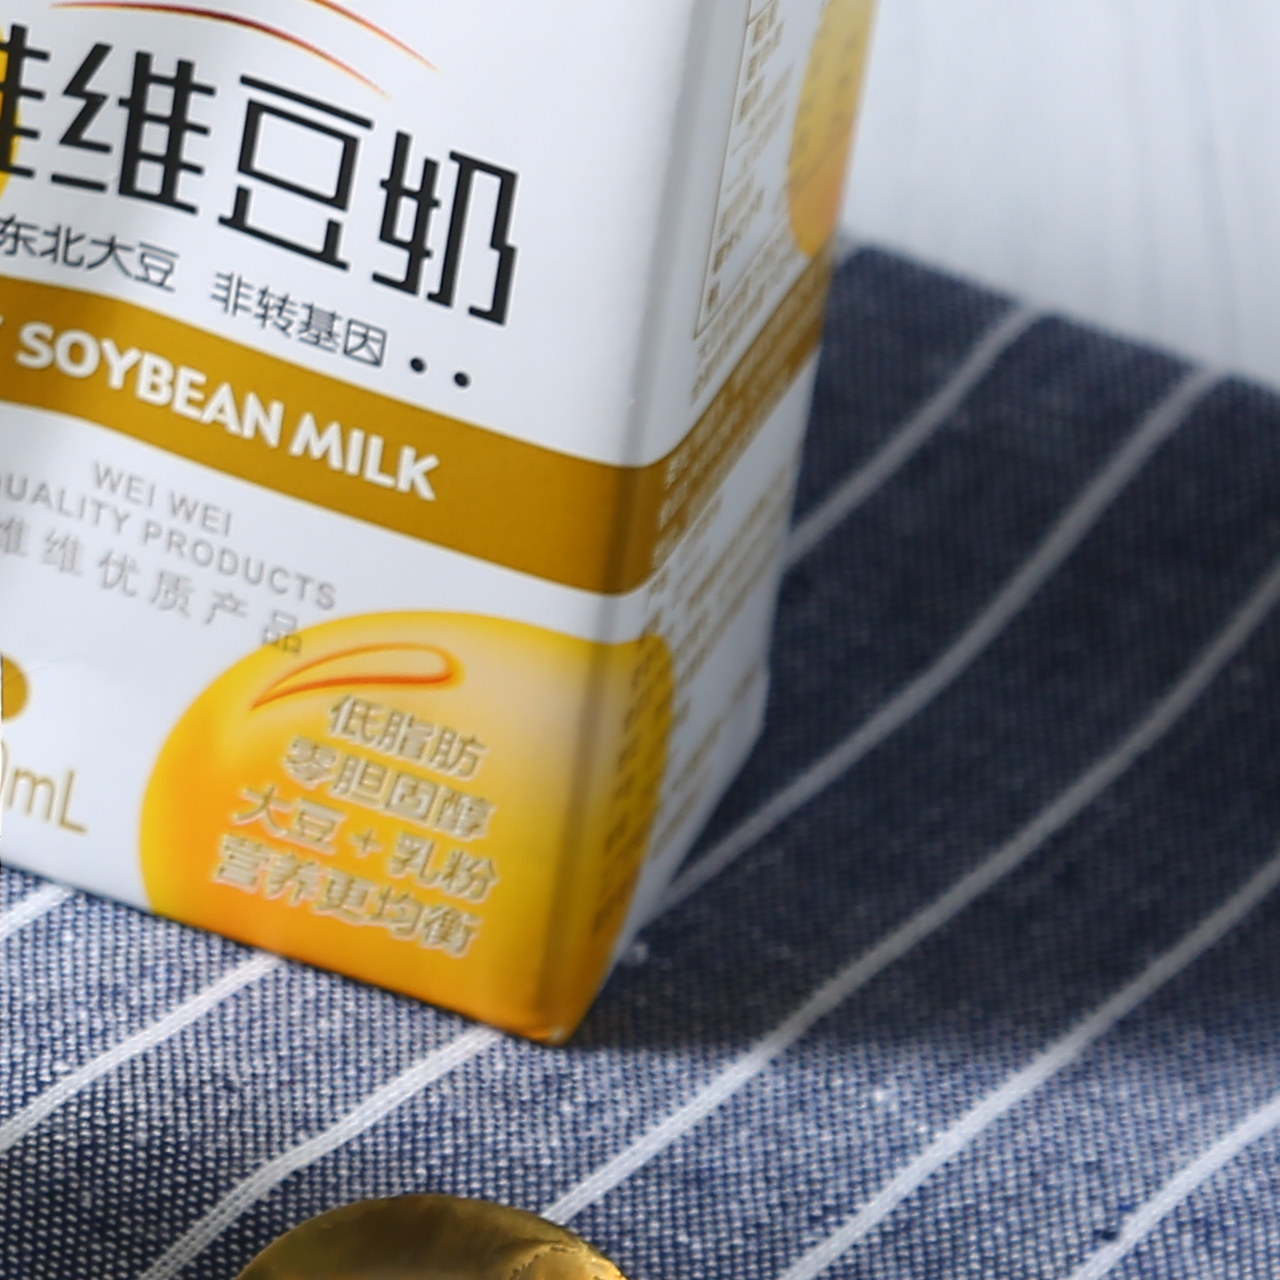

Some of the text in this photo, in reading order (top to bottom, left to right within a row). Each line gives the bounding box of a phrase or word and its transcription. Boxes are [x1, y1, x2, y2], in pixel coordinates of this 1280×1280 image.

[210, 271, 388, 369] 非转基因
[17, 322, 285, 447] SOYBEAN
[289, 412, 439, 501] MILK
[94, 461, 233, 537] WEI WEI
[143, 520, 336, 612] PRODUCTS
[331, 695, 487, 780] 低脂肪
[0, 740, 88, 835] mL
[284, 736, 495, 841] 零胆固醇
[214, 835, 481, 958] 营养更均衡
